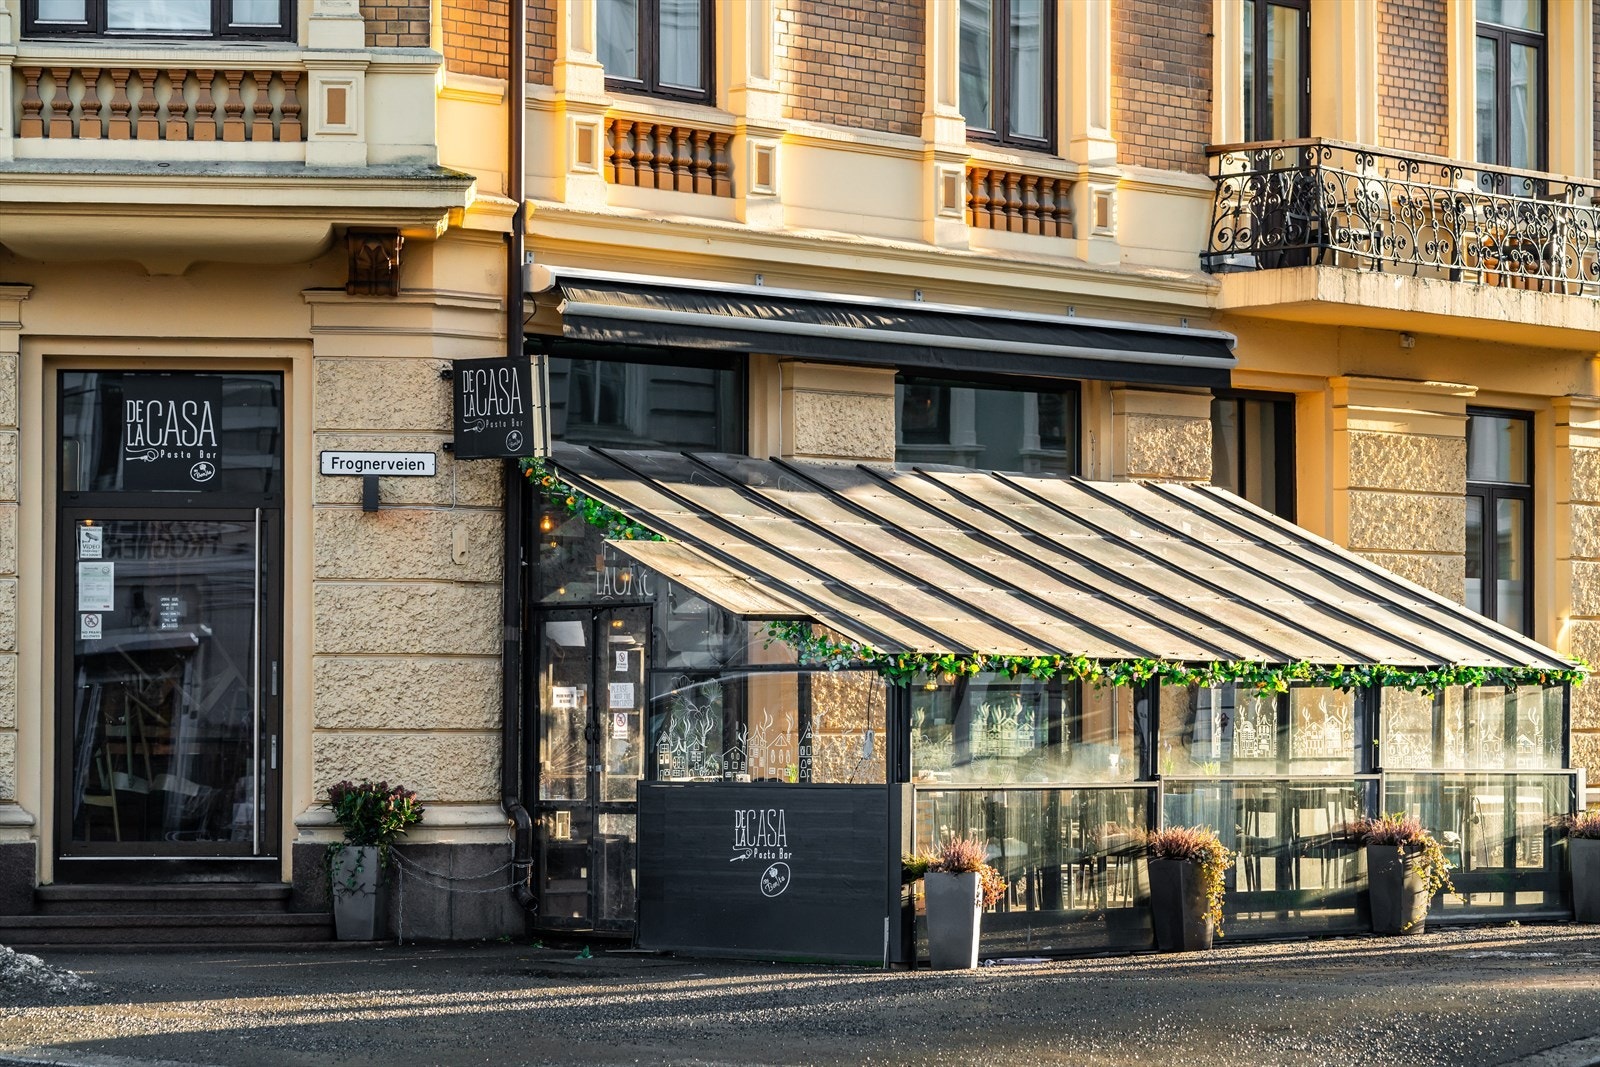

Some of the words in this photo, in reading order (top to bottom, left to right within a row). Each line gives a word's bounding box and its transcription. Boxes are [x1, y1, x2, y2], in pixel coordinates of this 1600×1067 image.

[463, 370, 474, 393] DE
[475, 367, 523, 416] CASA
[126, 400, 144, 422] DE
[463, 394, 476, 417] LA
[146, 400, 217, 446] CASA
[486, 419, 506, 428] Pasta
[511, 418, 523, 427] Bar
[127, 424, 145, 446] LA
[160, 449, 191, 459] Pasta
[199, 449, 216, 459] Bar
[331, 456, 425, 472] Frognerveien
[735, 809, 746, 828] DE
[746, 809, 787, 847] CASA
[735, 828, 746, 846] LA
[753, 848, 776, 859] Pasta
[779, 848, 792, 859] Bar
